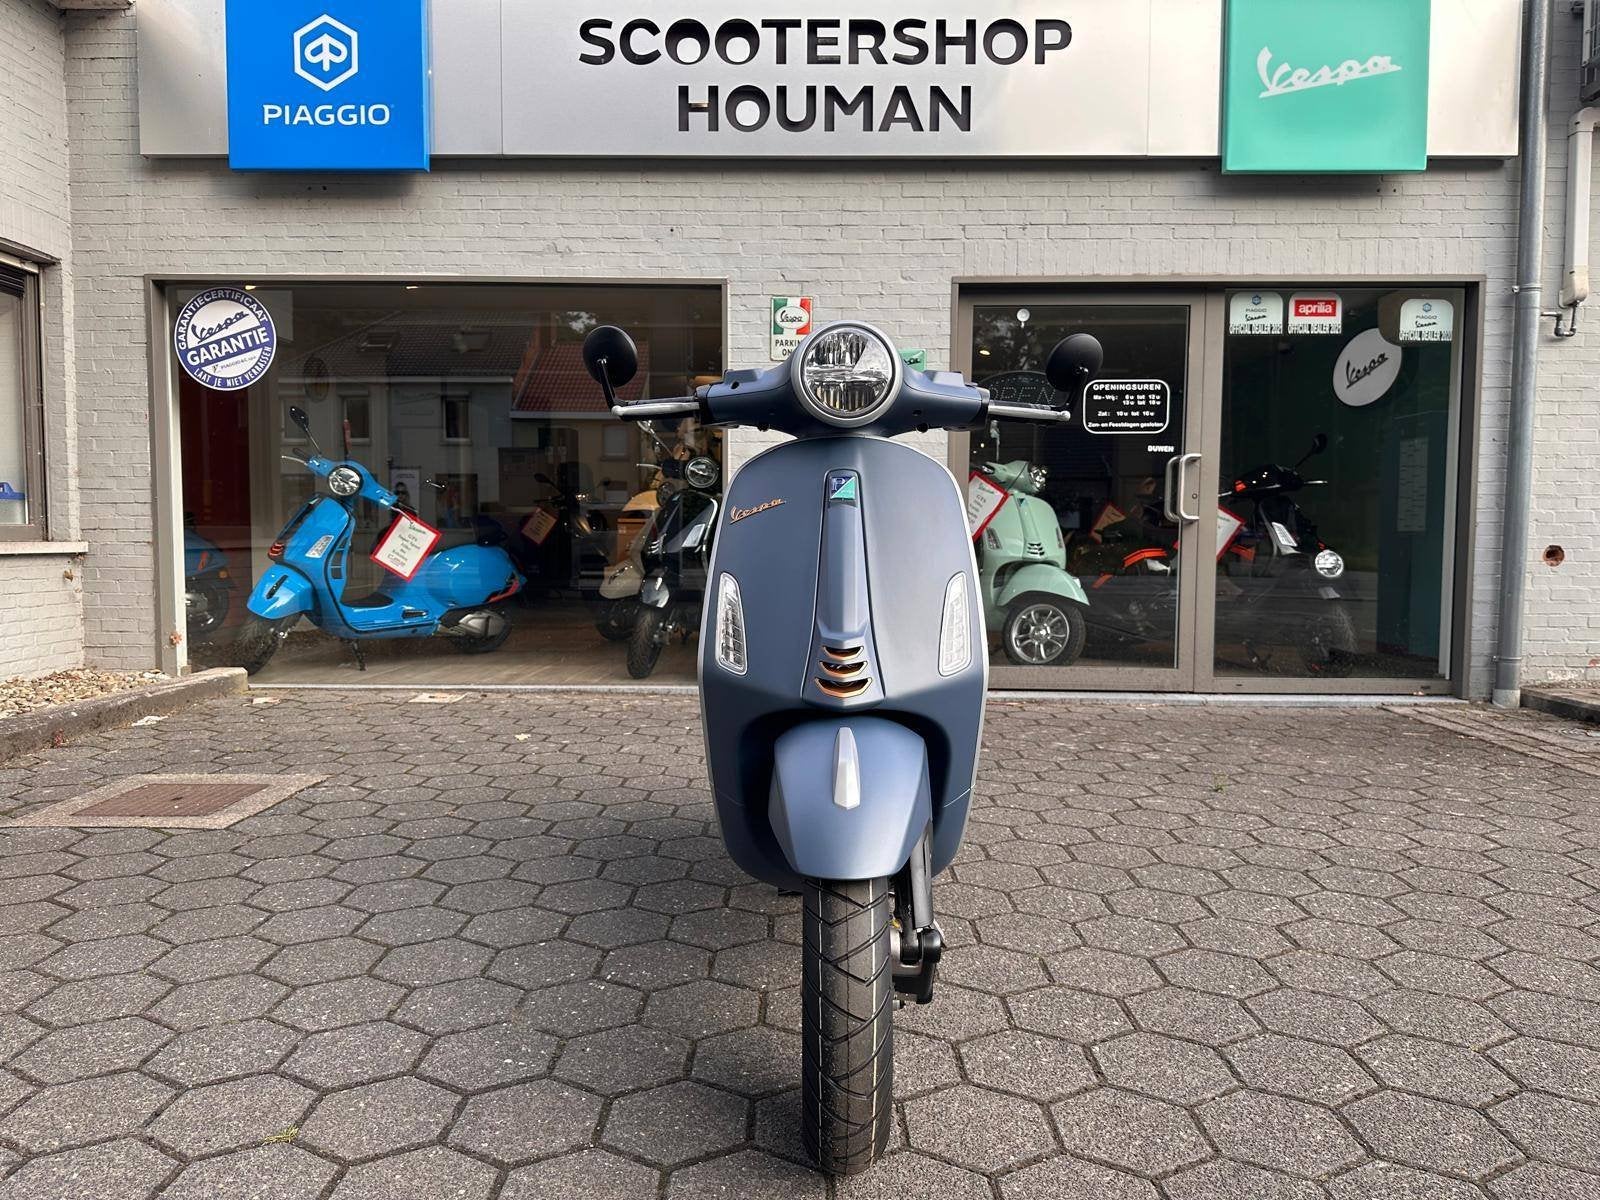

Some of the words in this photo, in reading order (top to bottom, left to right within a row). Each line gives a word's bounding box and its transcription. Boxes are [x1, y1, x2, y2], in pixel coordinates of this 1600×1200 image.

[578, 18, 1073, 66] SCOOTERSHOP
[1256, 46, 1402, 98] Vespa
[262, 104, 390, 126] PIAGGIO
[677, 85, 972, 133] HOUMAN
[178, 289, 268, 350] GARANTIECERTIFICAAT
[190, 311, 250, 345] Vespa
[1298, 301, 1333, 316] aprilia
[186, 326, 270, 367] GARANTIE
[193, 368, 212, 383] LAAT
[213, 378, 222, 388] JE
[226, 377, 245, 388] NIET
[245, 346, 273, 385] VERRASSEN
[1346, 352, 1389, 389] Vespa
[1147, 445, 1175, 453] DUWEN
[729, 496, 787, 525] Vespa
